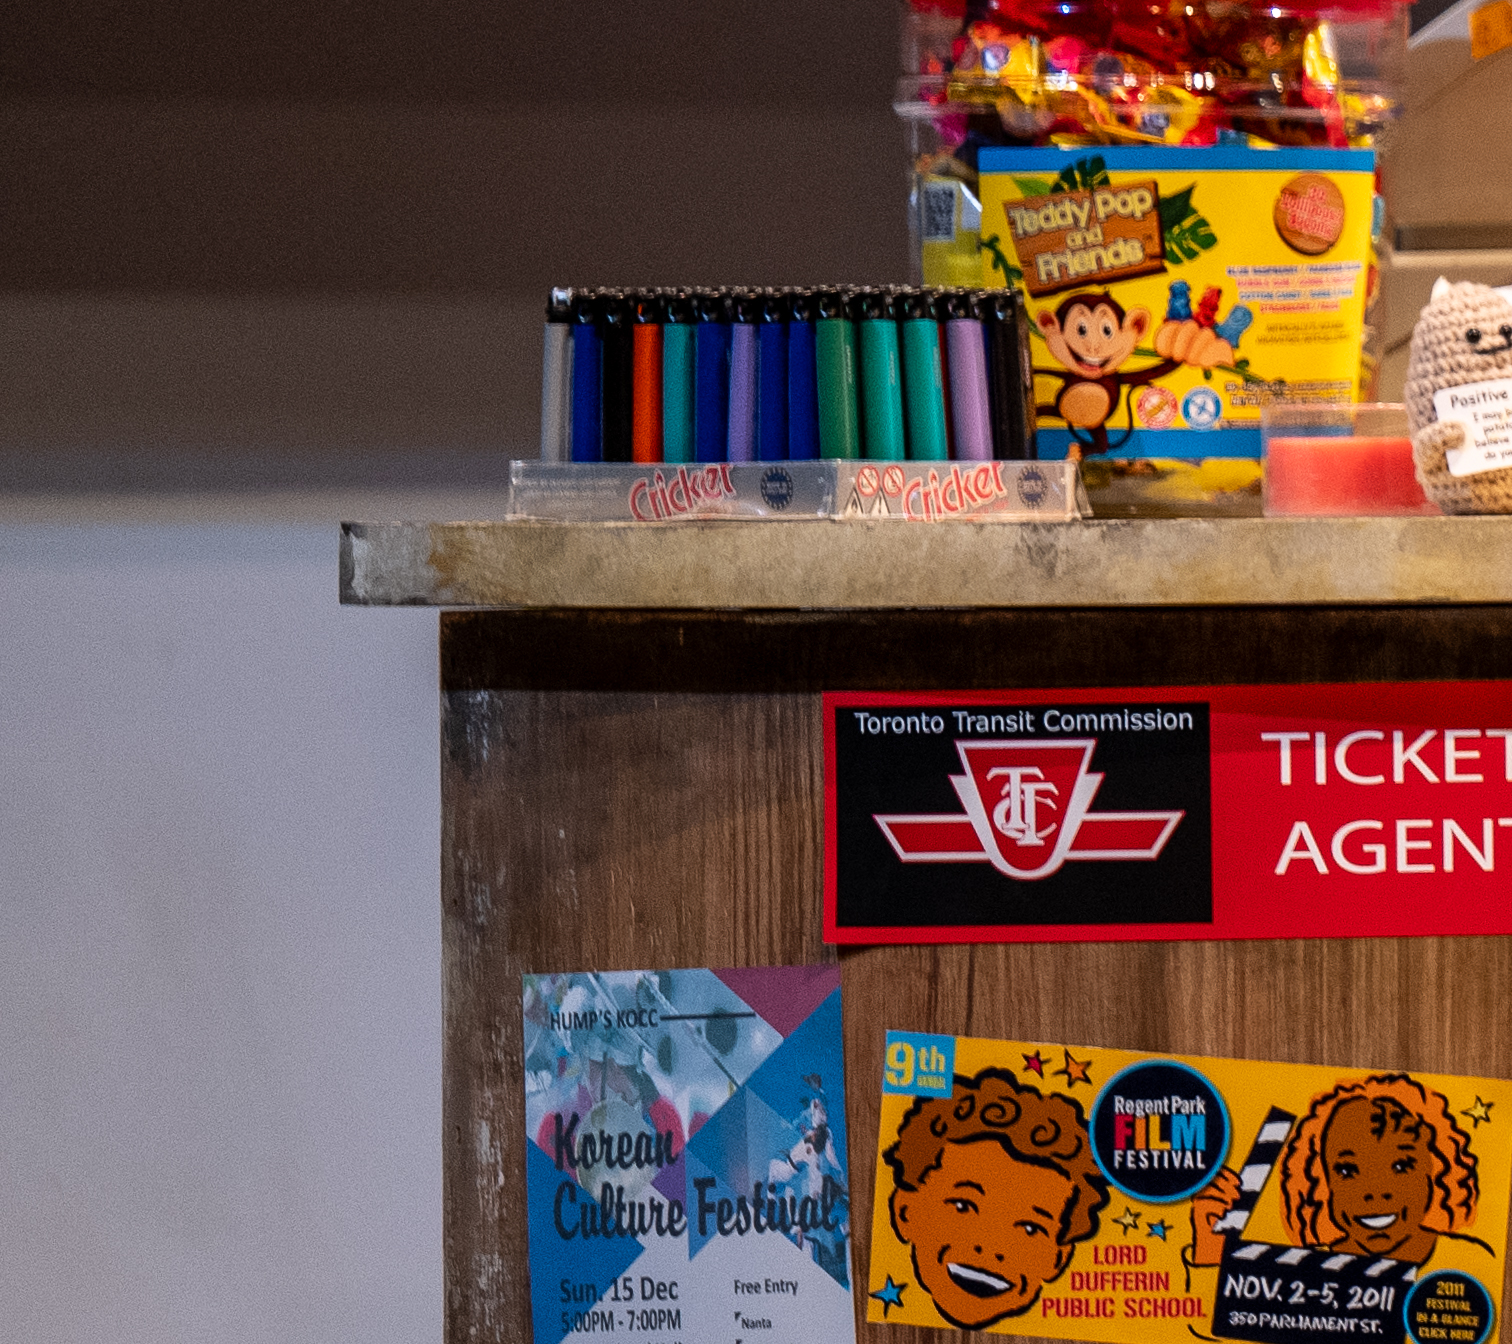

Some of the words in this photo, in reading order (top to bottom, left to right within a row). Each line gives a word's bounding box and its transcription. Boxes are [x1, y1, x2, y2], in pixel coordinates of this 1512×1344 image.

[1009, 197, 1092, 239] Teddy
[1093, 186, 1154, 221] Pop
[1065, 223, 1104, 249] and
[1034, 236, 1145, 284] Friends
[1450, 387, 1508, 409] Positive
[853, 711, 945, 735] Toronto
[951, 709, 1035, 734] Transit
[1042, 708, 1194, 733] Commission
[884, 1040, 946, 1088] 9th
[1113, 1095, 1170, 1118] Regent
[1171, 1095, 1206, 1115] Park
[553, 1112, 678, 1170] Korean
[1113, 1150, 1206, 1170] FESTIVAL
[553, 1179, 688, 1241] Culture
[693, 1174, 840, 1237] Festival
[1093, 1245, 1147, 1265] LORD
[560, 1277, 603, 1304] Sun.
[611, 1276, 634, 1302] 15
[641, 1276, 679, 1301] Dec
[734, 1279, 762, 1295] Free
[764, 1277, 798, 1296] Entry
[1070, 1271, 1170, 1292] DUFFERIN
[1436, 1280, 1466, 1297] 2011
[1224, 1274, 1283, 1302] NOV.
[1288, 1280, 1339, 1309] 2-5,
[1347, 1286, 1396, 1312] 2011
[1041, 1297, 1116, 1318] PUBLIC
[1123, 1297, 1207, 1319] SCHOOL
[1426, 1297, 1472, 1312] FESTIVAL
[561, 1310, 615, 1333] 5:00PM
[628, 1309, 682, 1332] 7:00PM
[741, 1317, 772, 1330] Nanta
[1259, 1314, 1361, 1332] PARLIAMENT
[1363, 1320, 1384, 1334] ST.
[1430, 1312, 1438, 1324] A
[1418, 1326, 1448, 1339] CLICK
[1450, 1328, 1475, 1341] HERE
